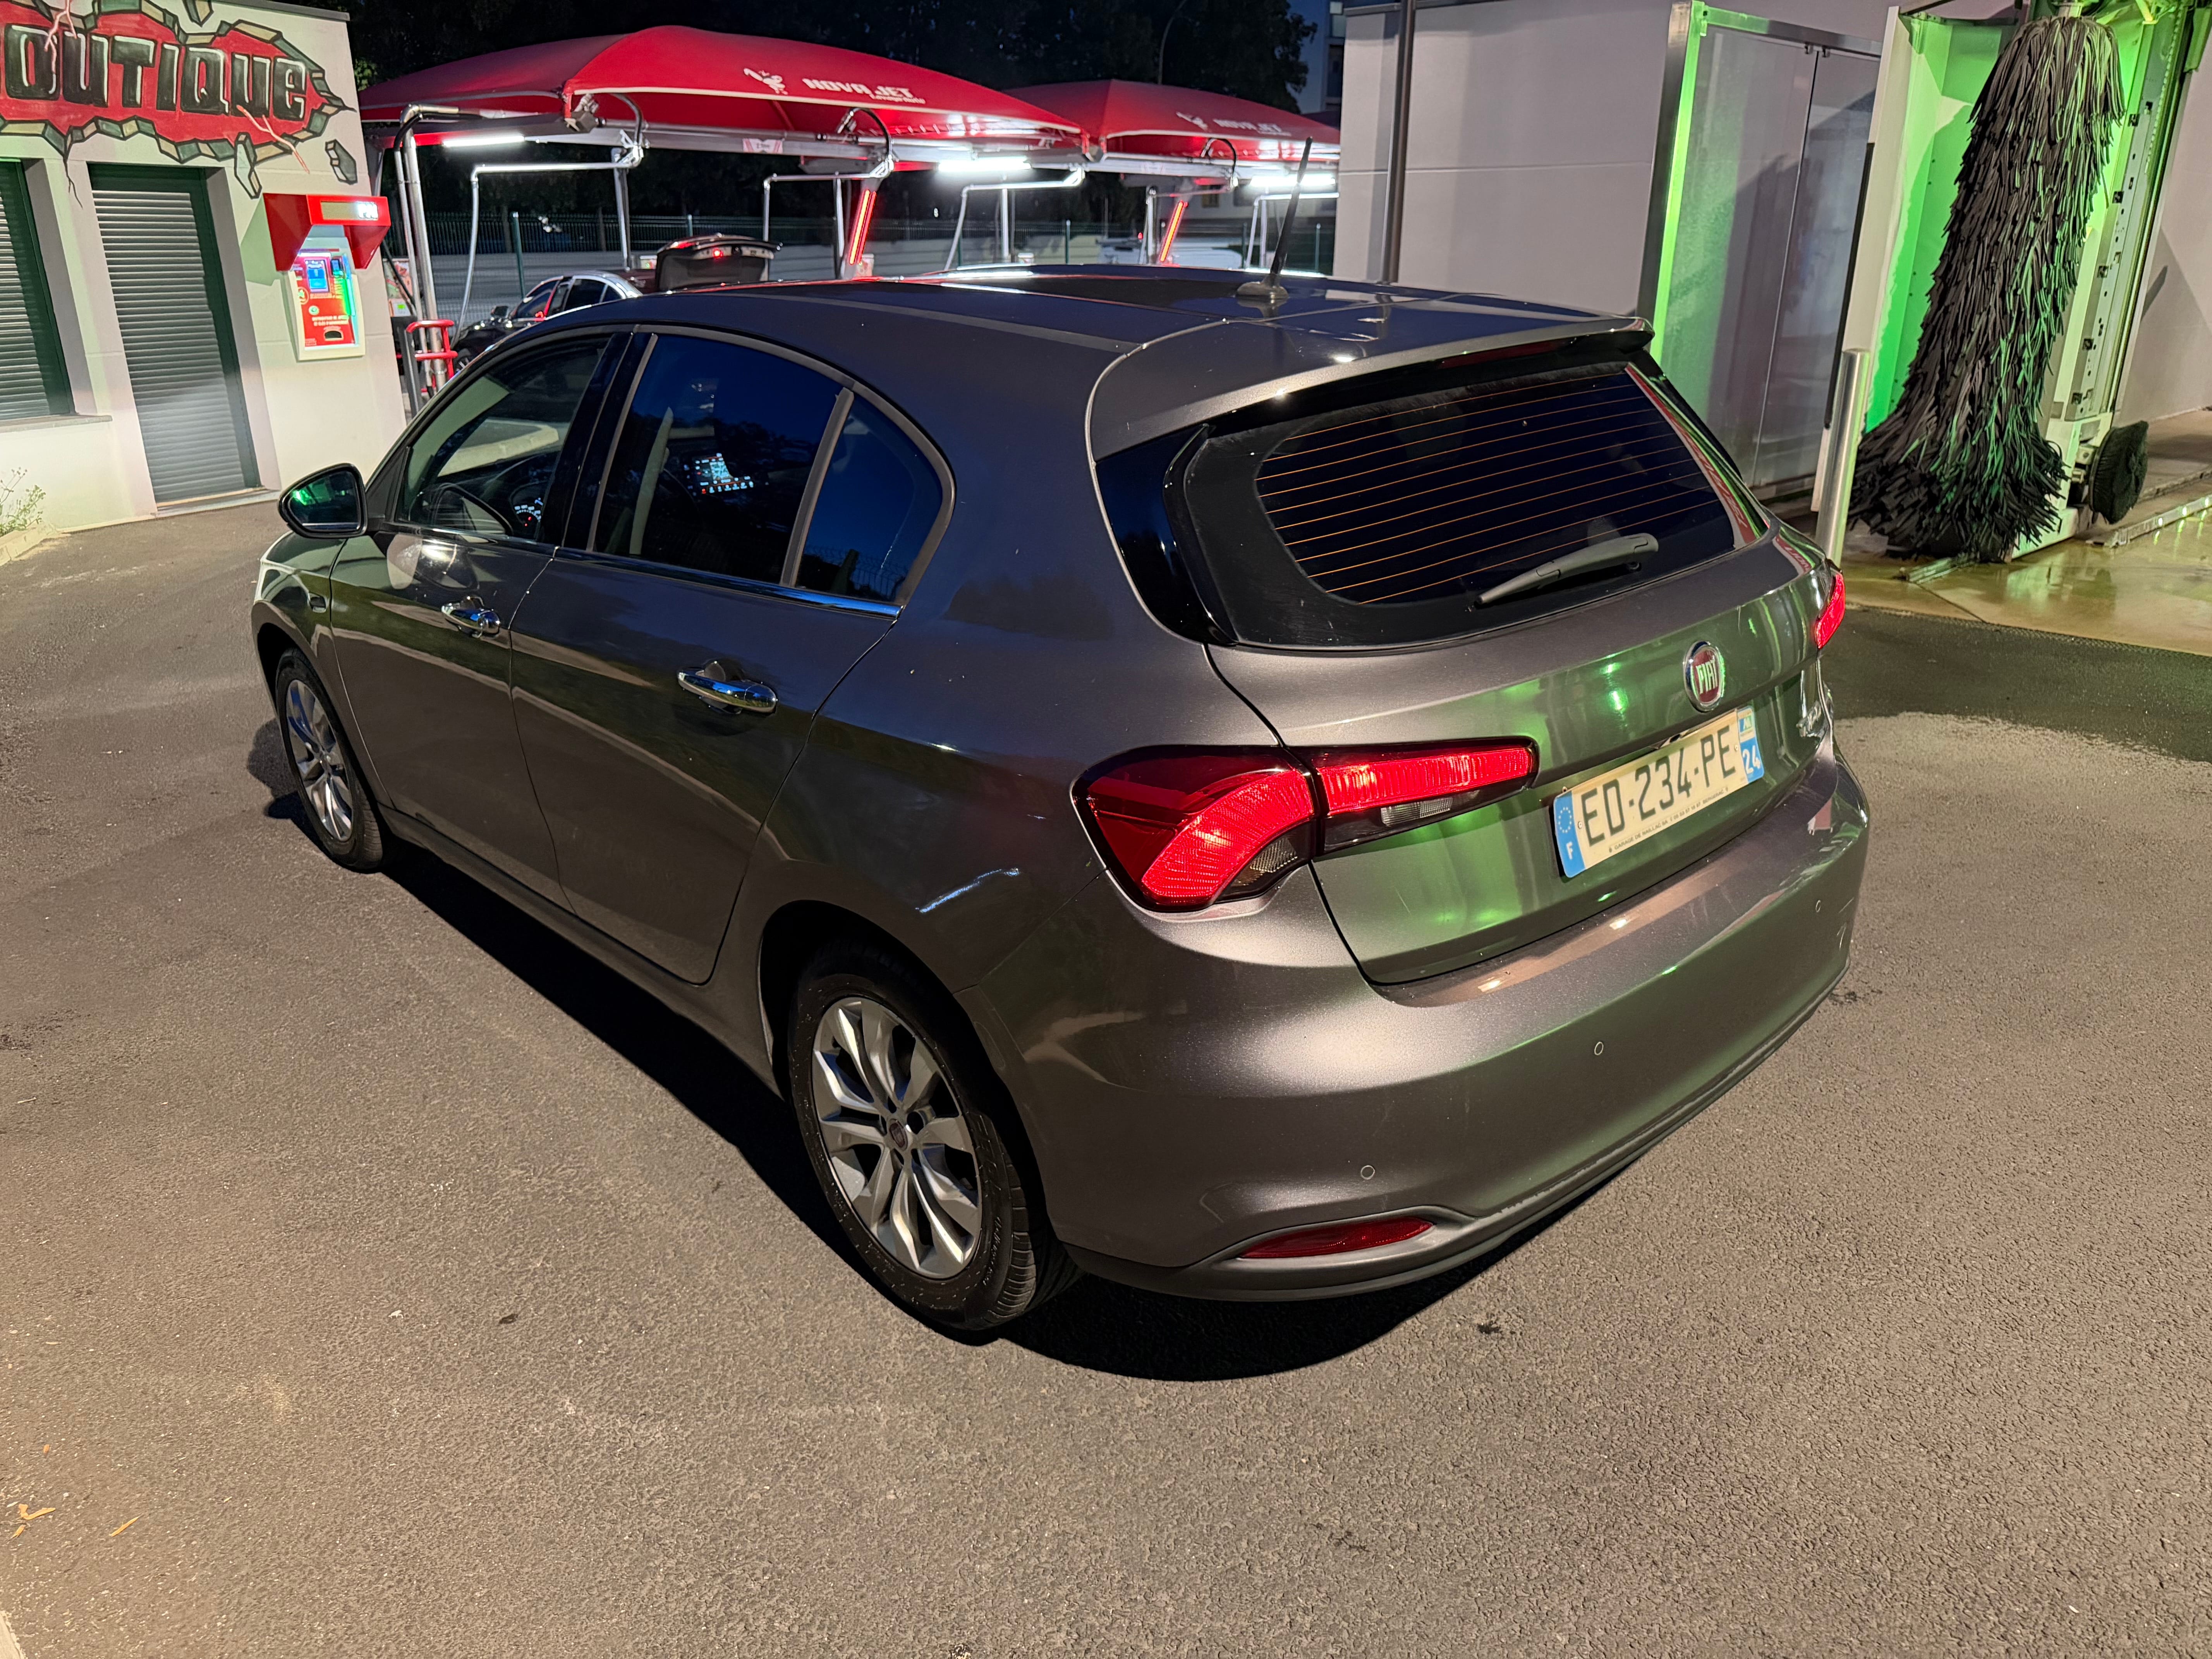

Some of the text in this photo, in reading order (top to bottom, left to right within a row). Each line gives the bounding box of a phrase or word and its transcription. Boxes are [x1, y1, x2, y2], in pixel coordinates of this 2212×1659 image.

[0, 23, 307, 120] OUTIQUE
[802, 78, 914, 98] NOVA JET
[1696, 659, 1718, 695] FIAT
[1743, 745, 1761, 775] 24
[1566, 841, 1573, 860] F
[1614, 837, 1633, 850] GARAGE
